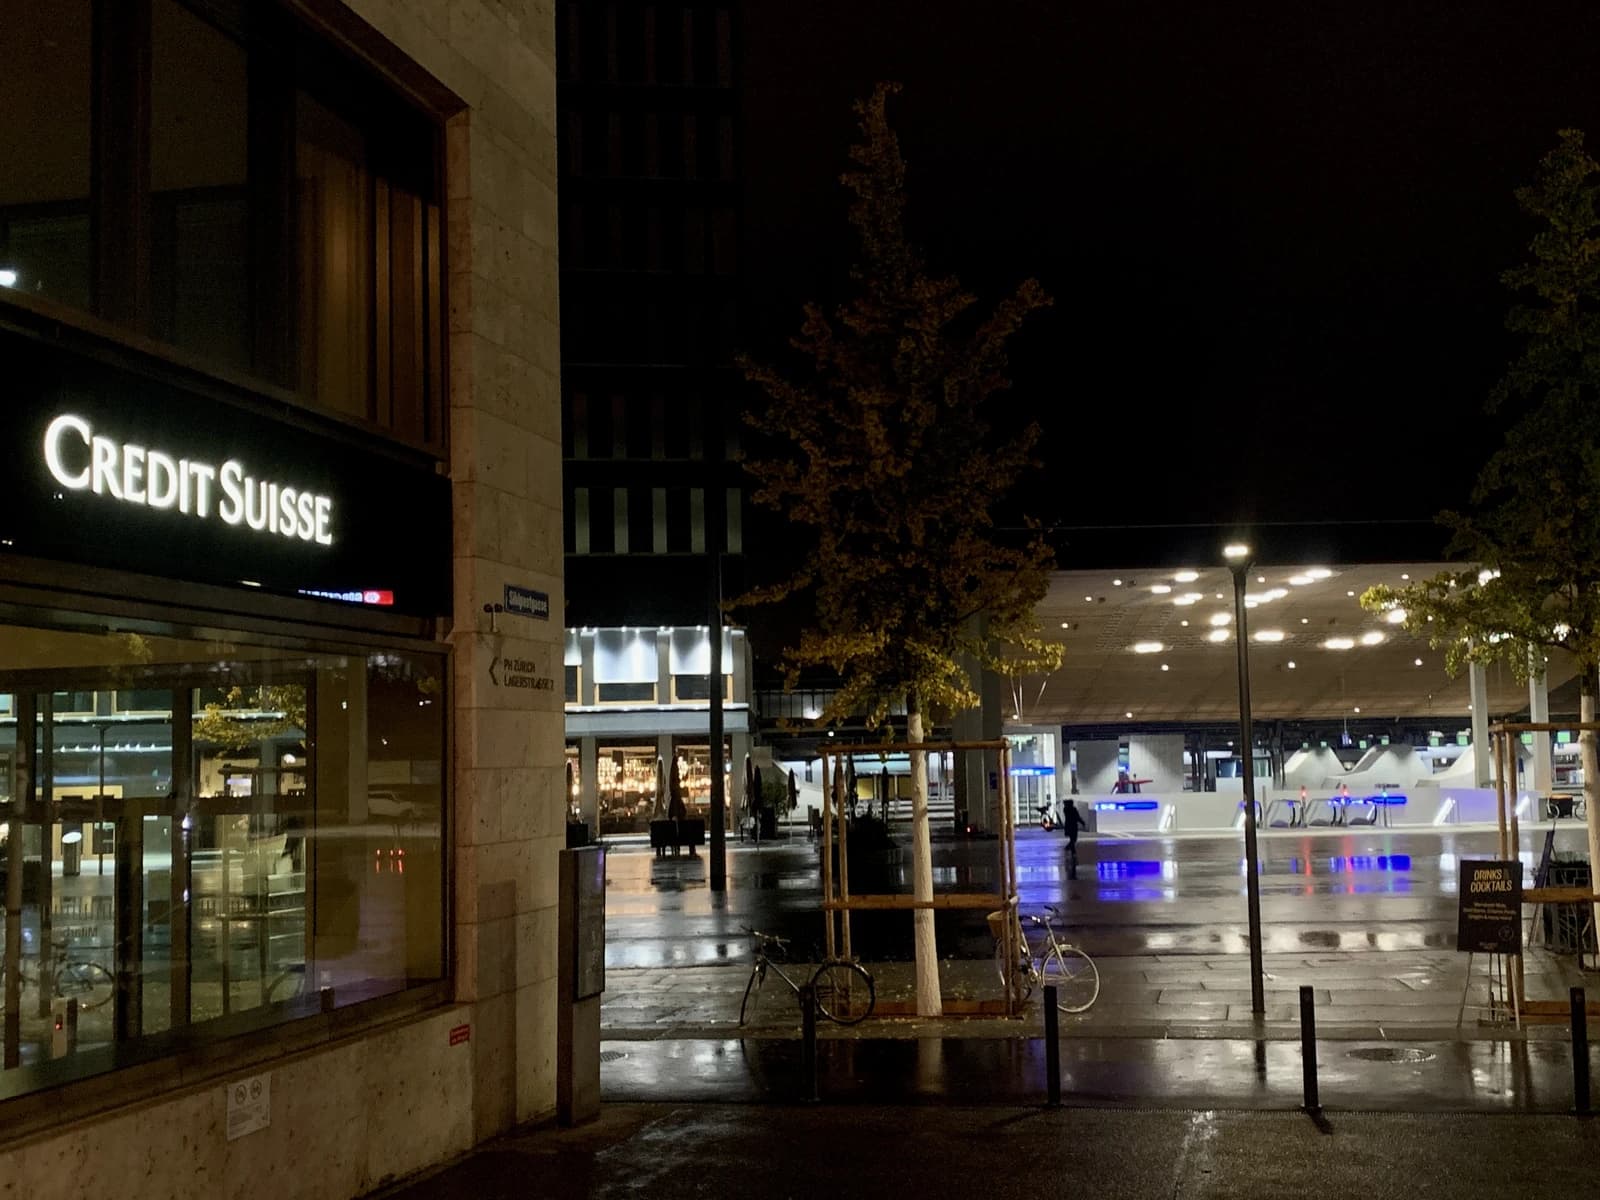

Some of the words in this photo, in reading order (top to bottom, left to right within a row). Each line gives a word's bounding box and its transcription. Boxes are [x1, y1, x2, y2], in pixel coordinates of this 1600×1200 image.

[44, 414, 214, 518] CREDIT
[219, 459, 333, 546] SUISSE
[1474, 868, 1502, 881] DRINKS
[1470, 880, 1513, 893] COCKTAILS
